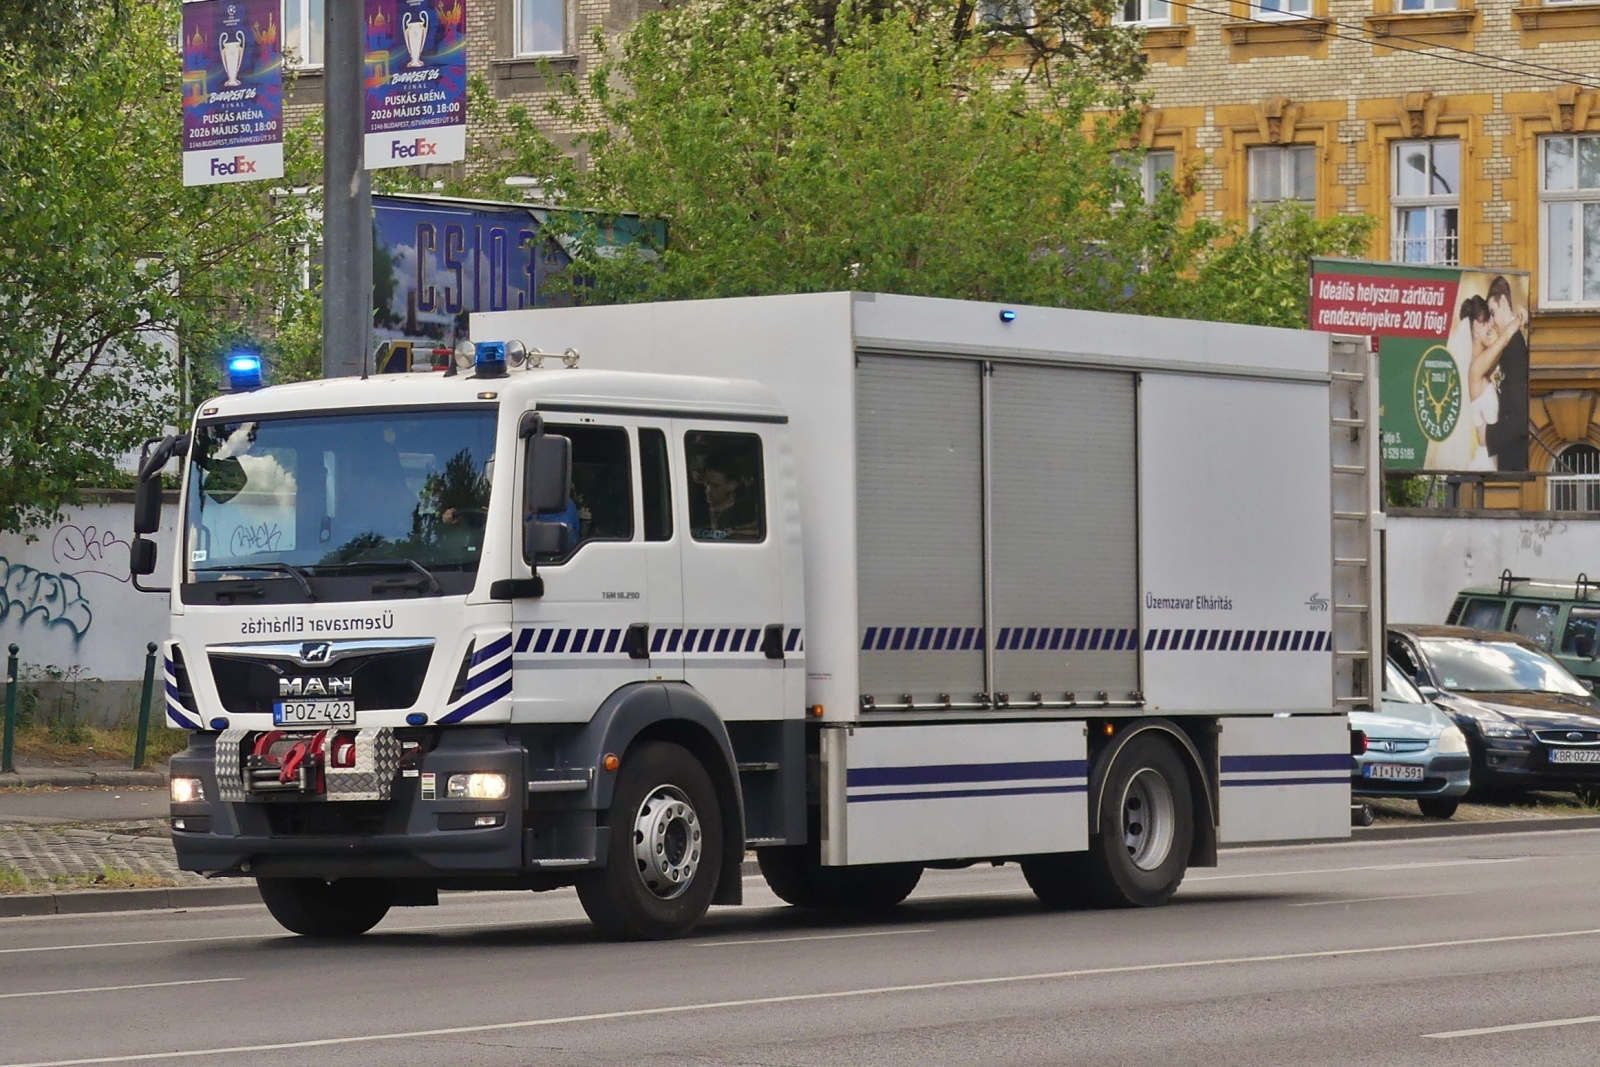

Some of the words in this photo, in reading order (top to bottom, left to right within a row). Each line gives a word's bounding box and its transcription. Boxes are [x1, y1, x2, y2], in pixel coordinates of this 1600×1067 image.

[385, 91, 417, 106] PUSKÁS
[418, 89, 447, 102] ARÉNA
[203, 110, 235, 124] PUSKÁS
[236, 108, 264, 121] ARÉNA
[371, 110, 392, 120] 2026
[393, 105, 420, 118] MÁJUS
[422, 105, 434, 116] 30,
[436, 102, 460, 113] 18:00
[189, 128, 210, 138] 2026
[211, 123, 239, 136] MÁJUS
[240, 123, 253, 134] 30,
[254, 121, 277, 132] 18:00
[391, 138, 437, 159] FedEx
[210, 155, 256, 176] FedEx
[1319, 280, 1355, 301] Ideális
[1357, 282, 1400, 306] helyszín
[1401, 285, 1445, 306] zártkörű
[1318, 306, 1401, 331] rendezvényekre
[1402, 310, 1422, 330] 200
[1423, 310, 1448, 335] főig!
[1418, 387, 1442, 437] TRÓFEA
[1442, 386, 1459, 433] GRILL
[1146, 591, 1195, 609] Üzemzavar
[1196, 595, 1233, 611] Elhárítás
[279, 677, 352, 696] MAN
[285, 702, 351, 720] POZ-423
[1554, 750, 1572, 762] KBR
[1574, 751, 1600, 762] 02722
